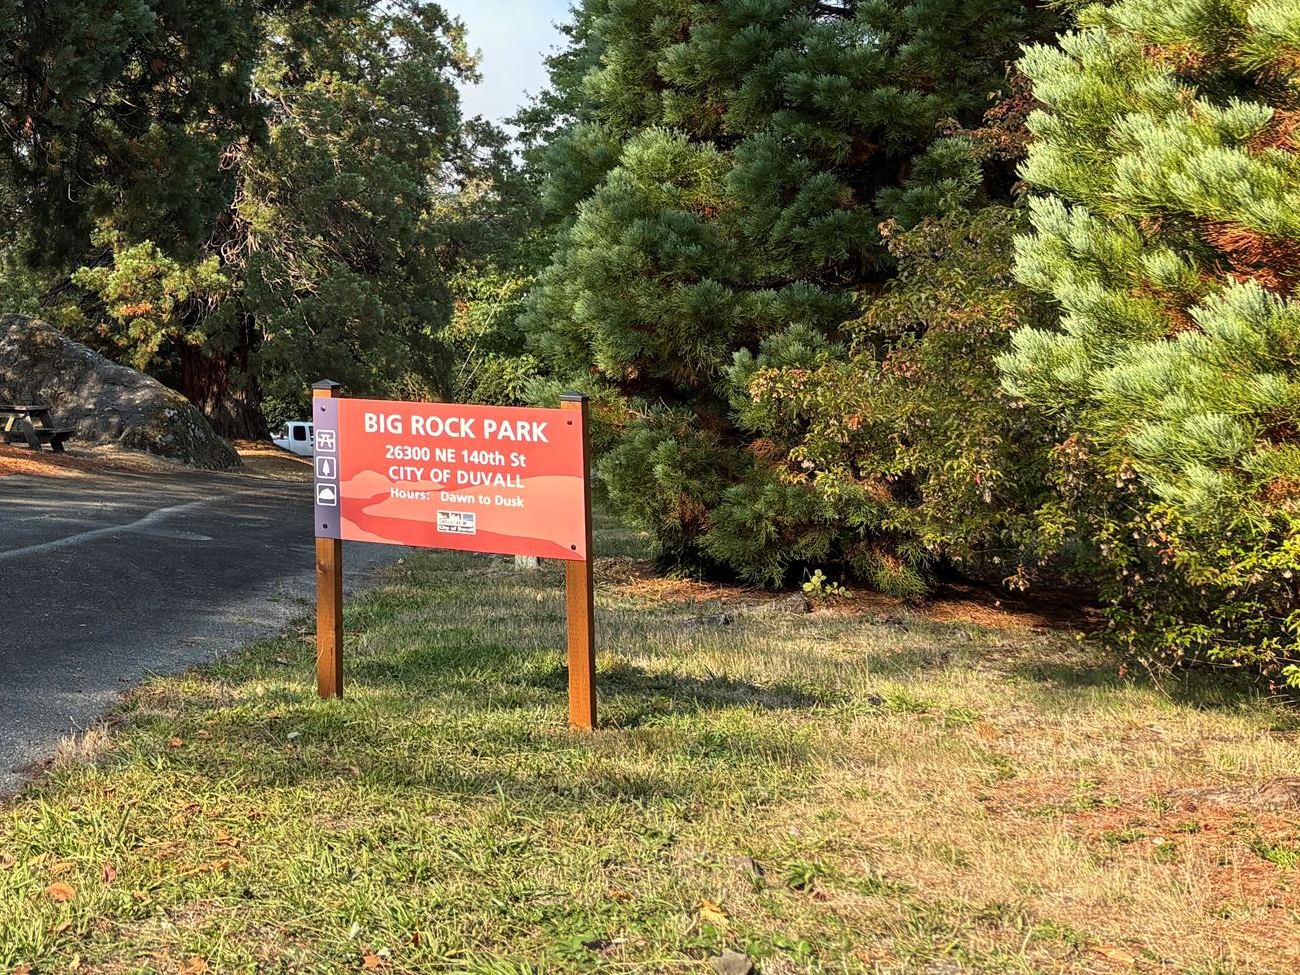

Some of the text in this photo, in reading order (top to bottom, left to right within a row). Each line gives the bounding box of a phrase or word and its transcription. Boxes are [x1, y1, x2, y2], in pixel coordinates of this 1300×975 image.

[364, 413, 548, 443] BIG ROCK PARK
[386, 445, 526, 467] 26300 NE 140th St
[389, 466, 524, 488] CITY OF DUVALL
[390, 488, 524, 507] Hours: Dawn to Dusk
